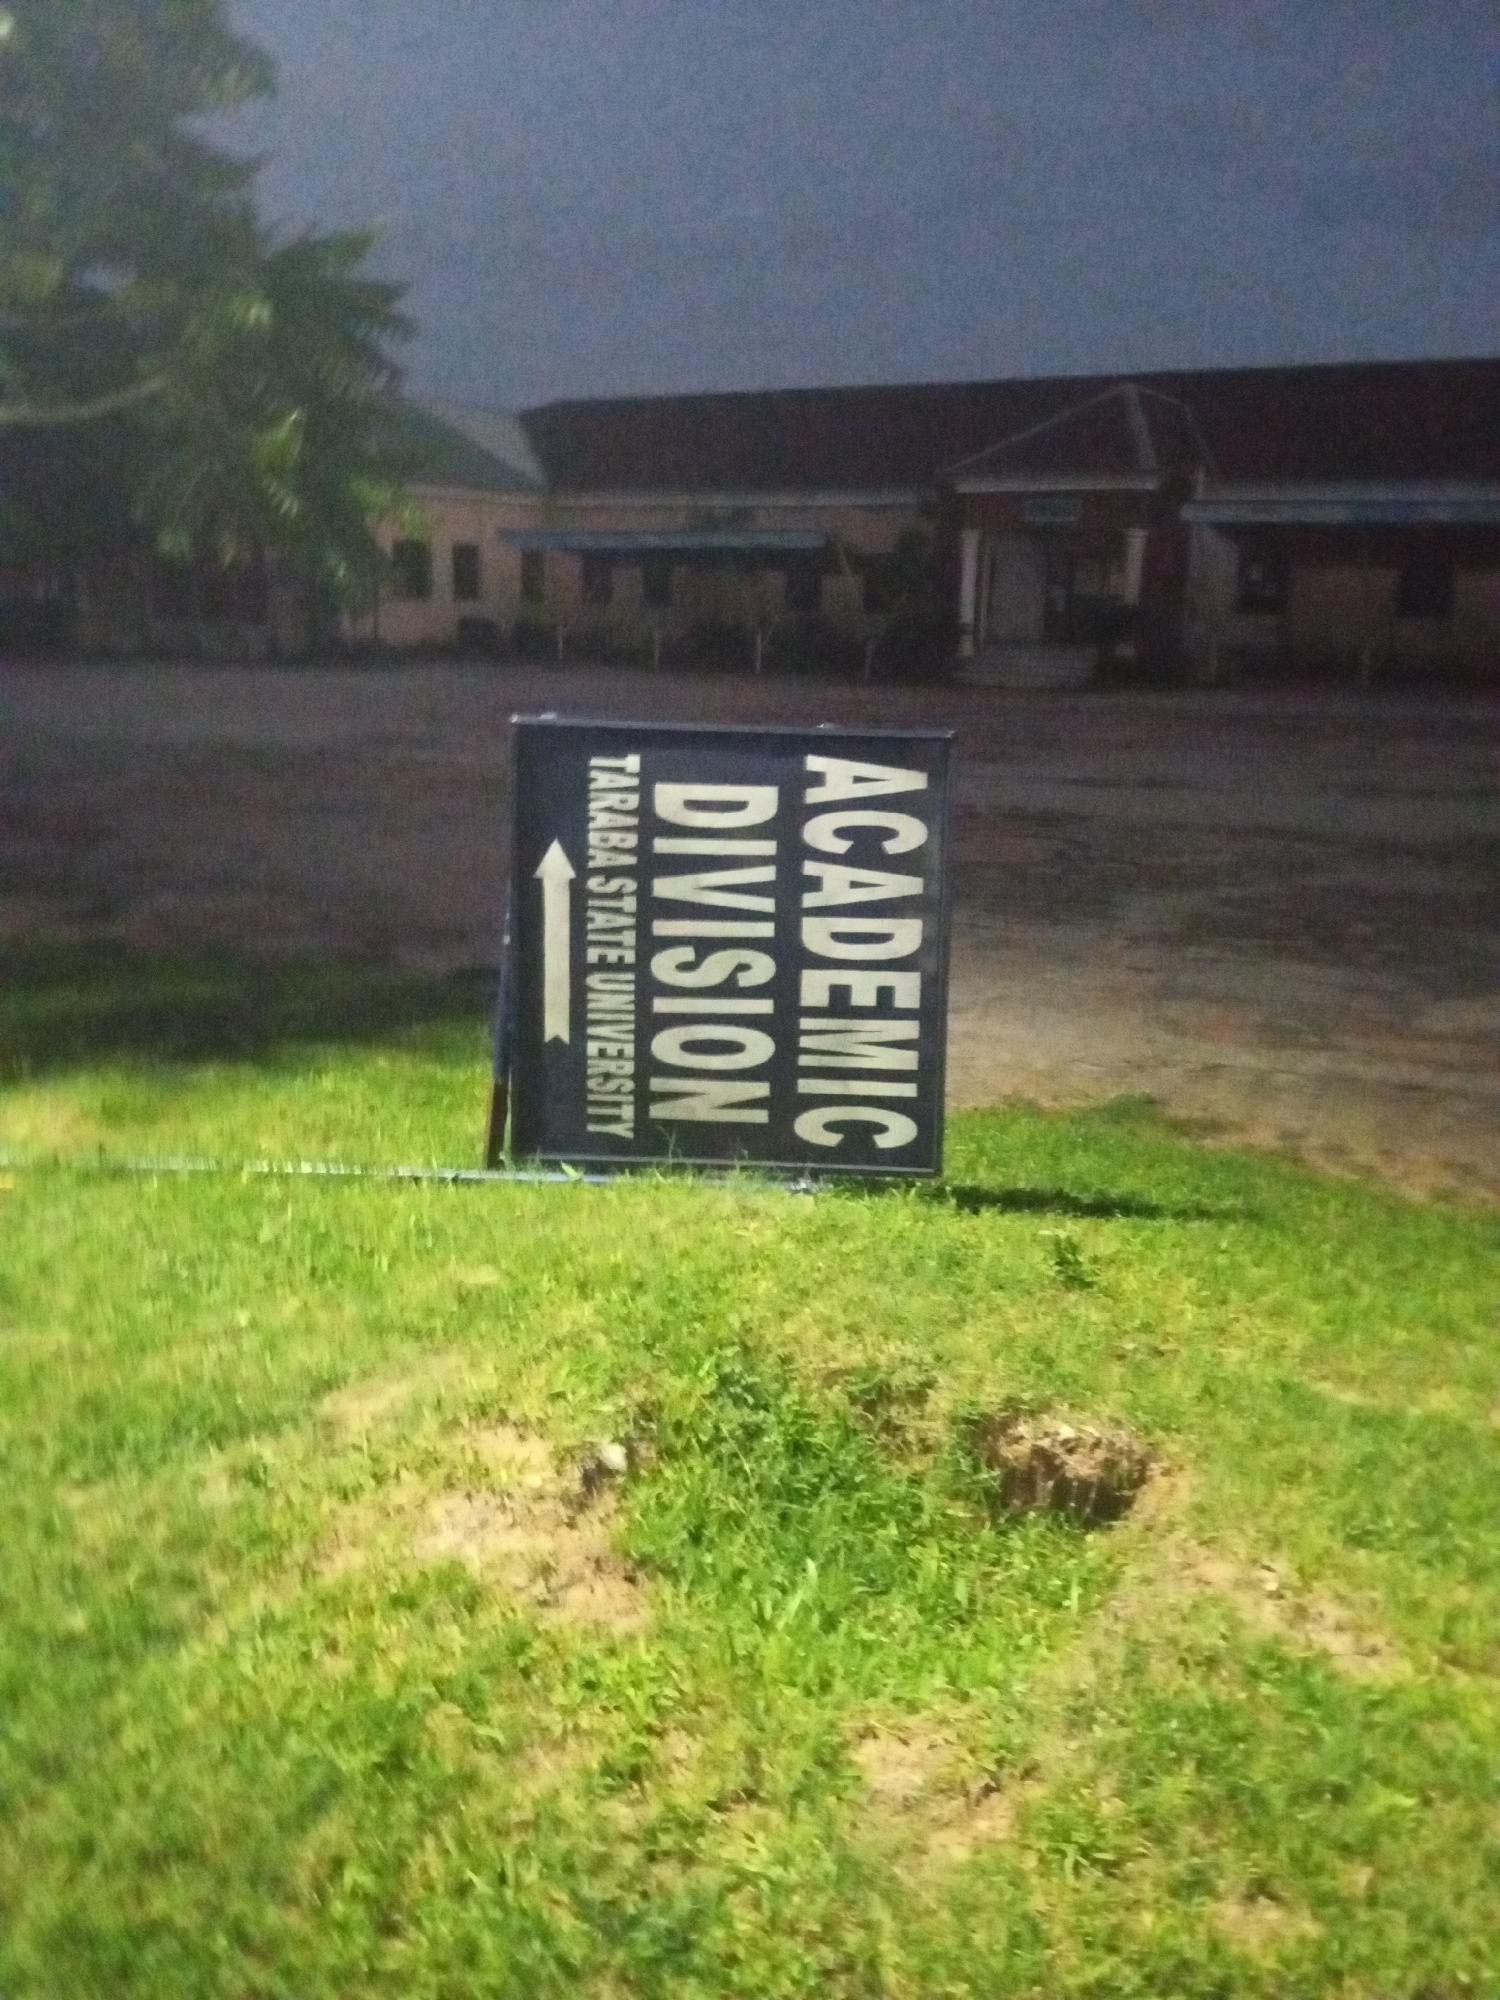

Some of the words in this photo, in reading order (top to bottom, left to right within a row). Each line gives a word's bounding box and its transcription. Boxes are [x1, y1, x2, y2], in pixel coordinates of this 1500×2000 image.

[587, 754, 640, 869] TARABA
[586, 876, 638, 964] STATE
[648, 782, 779, 1124] DIVISION
[793, 754, 928, 1149] ACADEMIC
[586, 972, 635, 1140] UNIVERSITY
